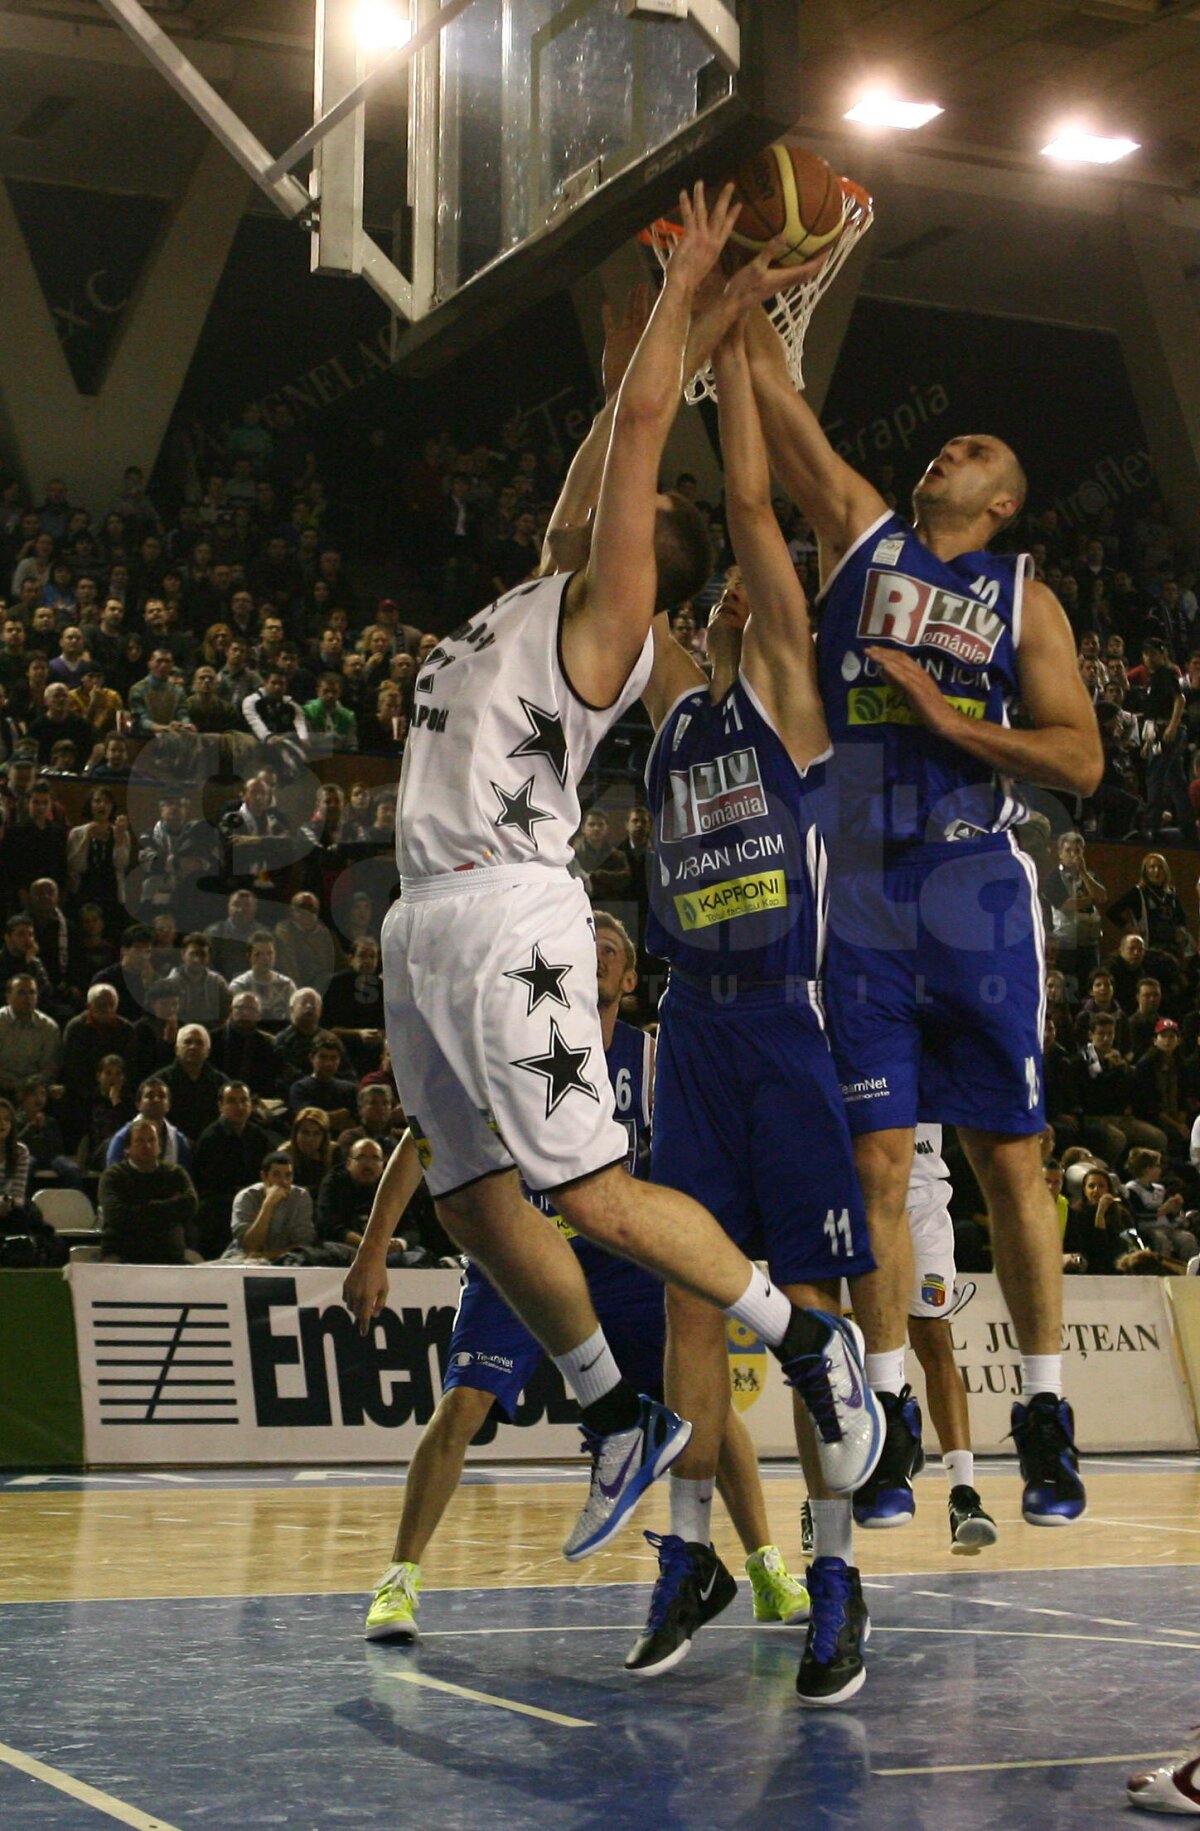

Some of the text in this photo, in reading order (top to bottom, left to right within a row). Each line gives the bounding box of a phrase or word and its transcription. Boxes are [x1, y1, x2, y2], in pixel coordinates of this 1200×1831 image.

[736, 834, 785, 863] ICIM
[823, 1208, 854, 1257] 11
[958, 1364, 1024, 1396] LUJ
